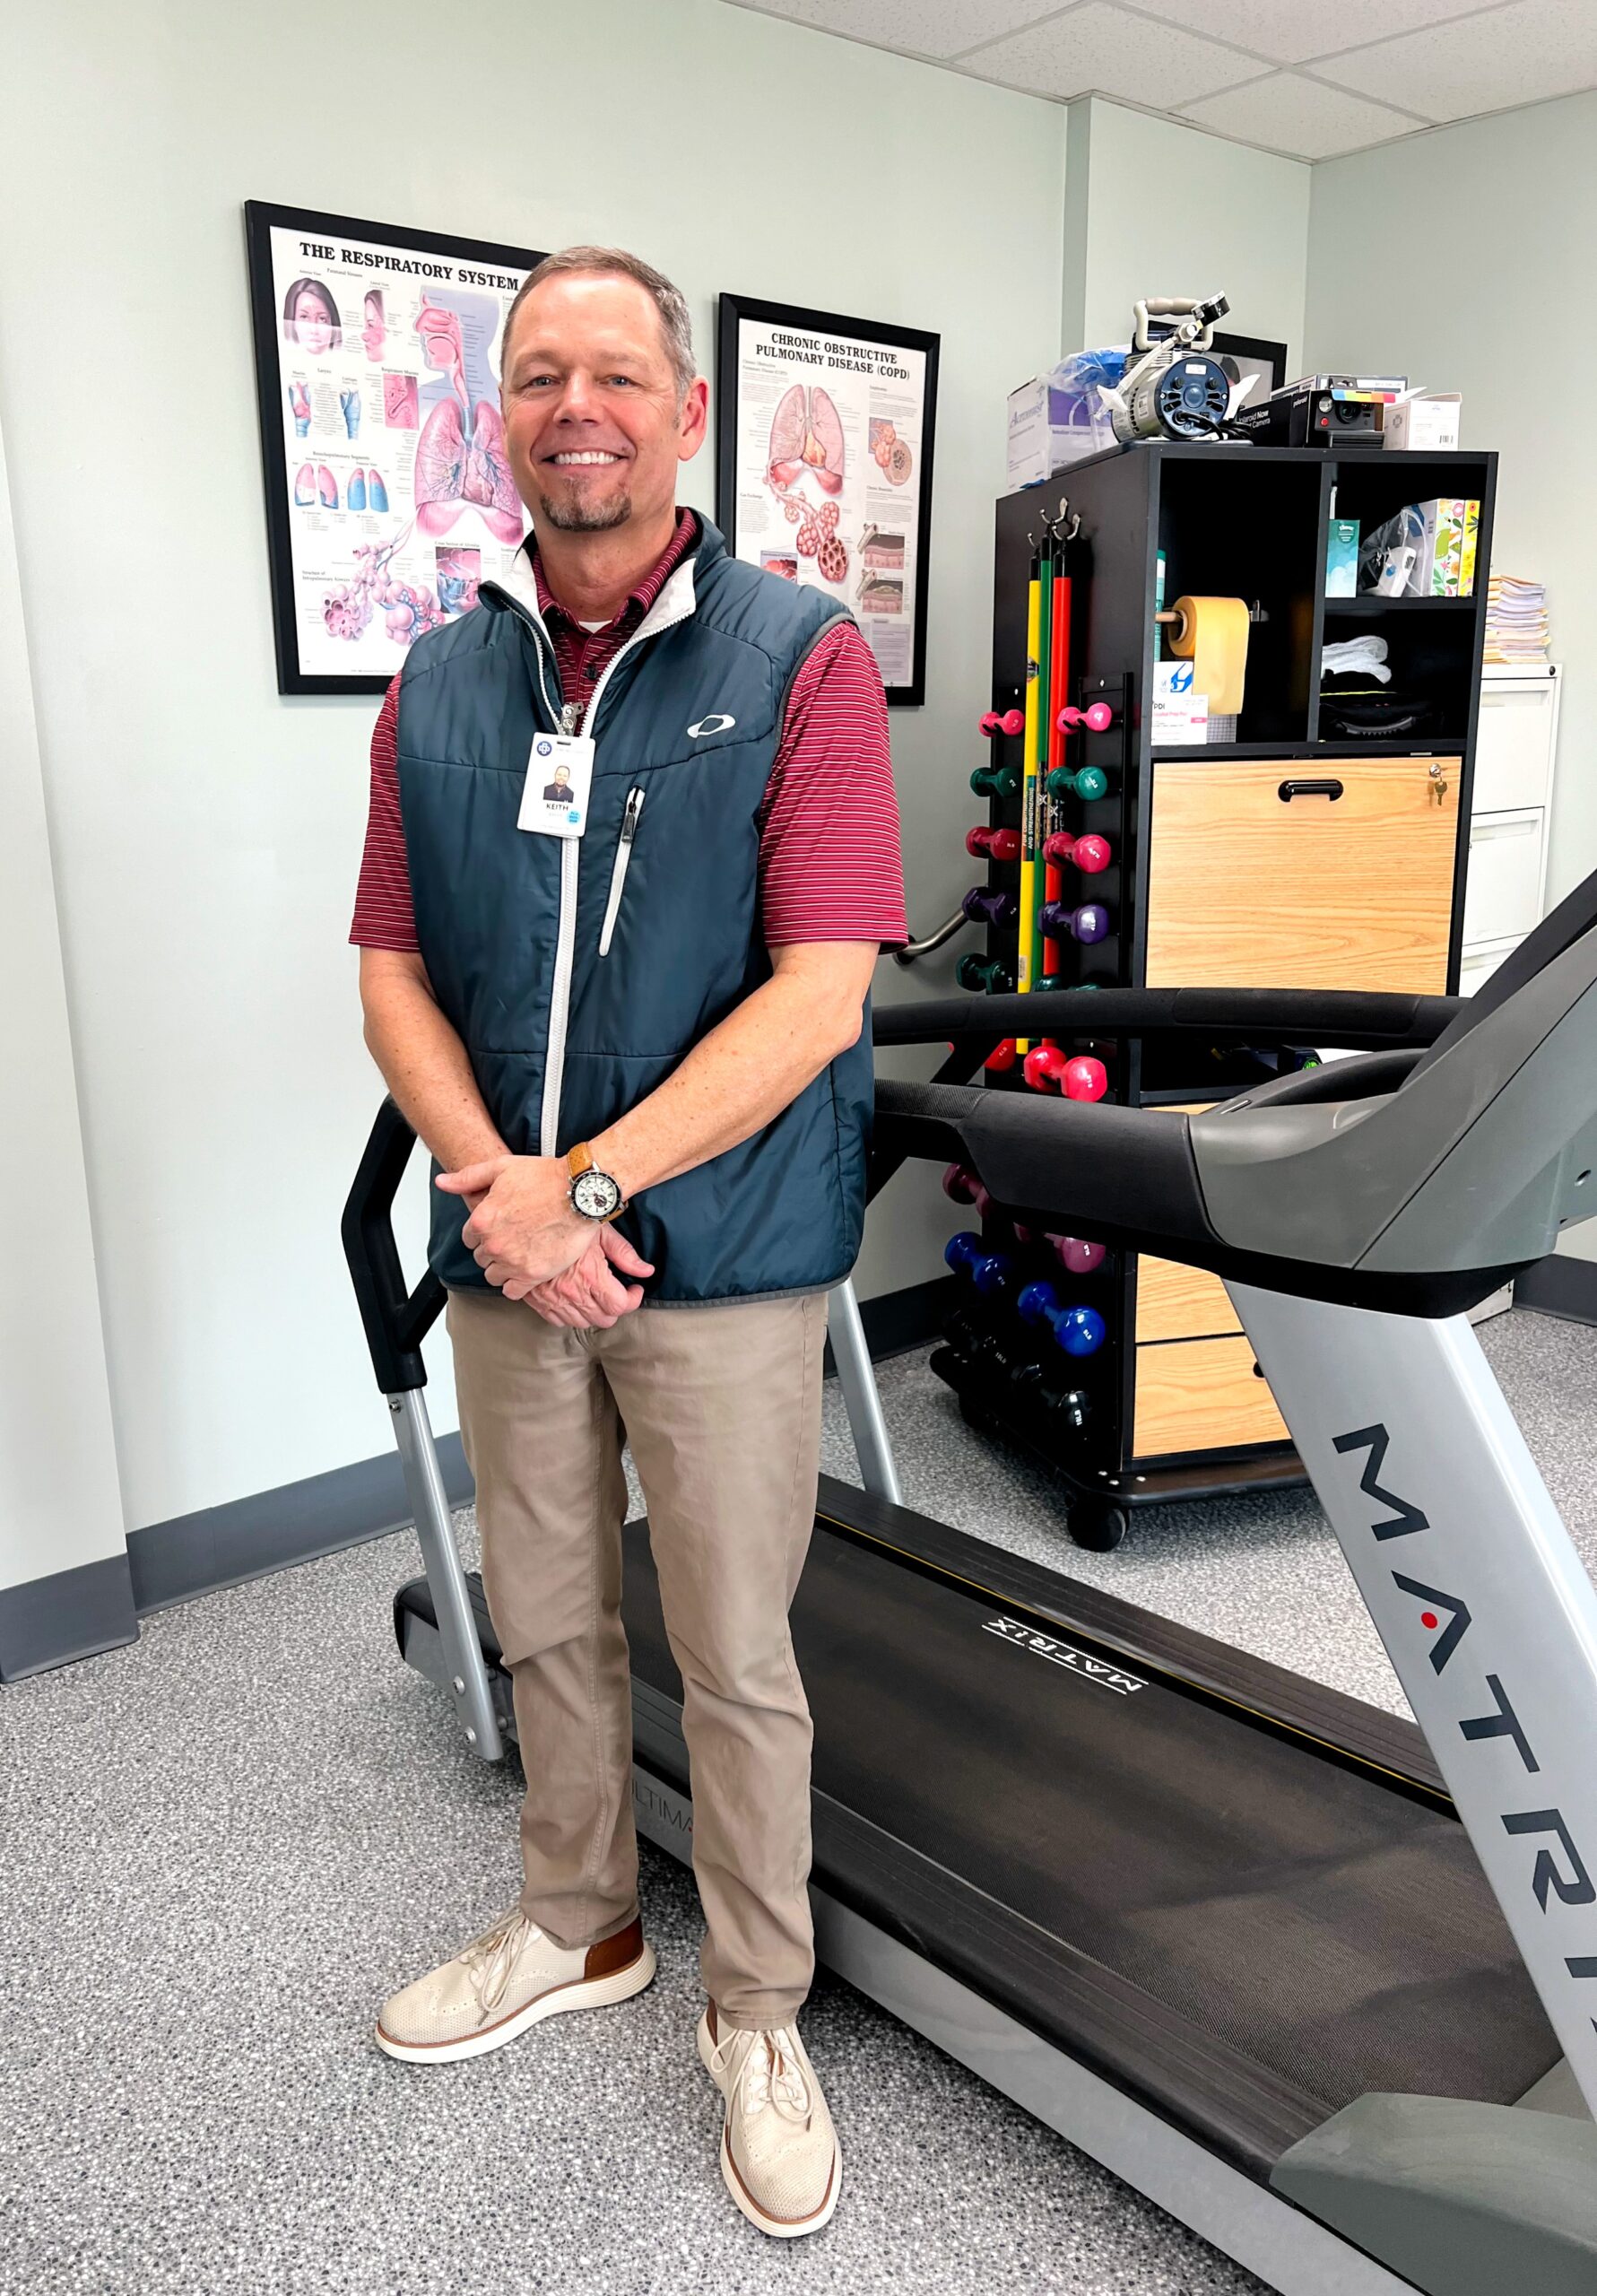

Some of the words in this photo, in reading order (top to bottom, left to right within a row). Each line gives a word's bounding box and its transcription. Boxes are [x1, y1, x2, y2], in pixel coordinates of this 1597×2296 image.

[300, 242, 335, 260] THE
[342, 250, 452, 280] RESPIRATORY
[458, 269, 518, 291] SYSTEM
[756, 344, 824, 366] PULMONARY
[829, 357, 873, 374] DISEASE
[877, 365, 909, 380] (COPD)
[771, 333, 820, 351] CHRONIC
[824, 343, 897, 364] OBSTRUCTIVE
[1252, 418, 1271, 429] Camera
[1257, 410, 1269, 419] Now
[988, 1618, 1142, 1692] MATRIX
[1332, 1422, 1597, 2034] MATRI
